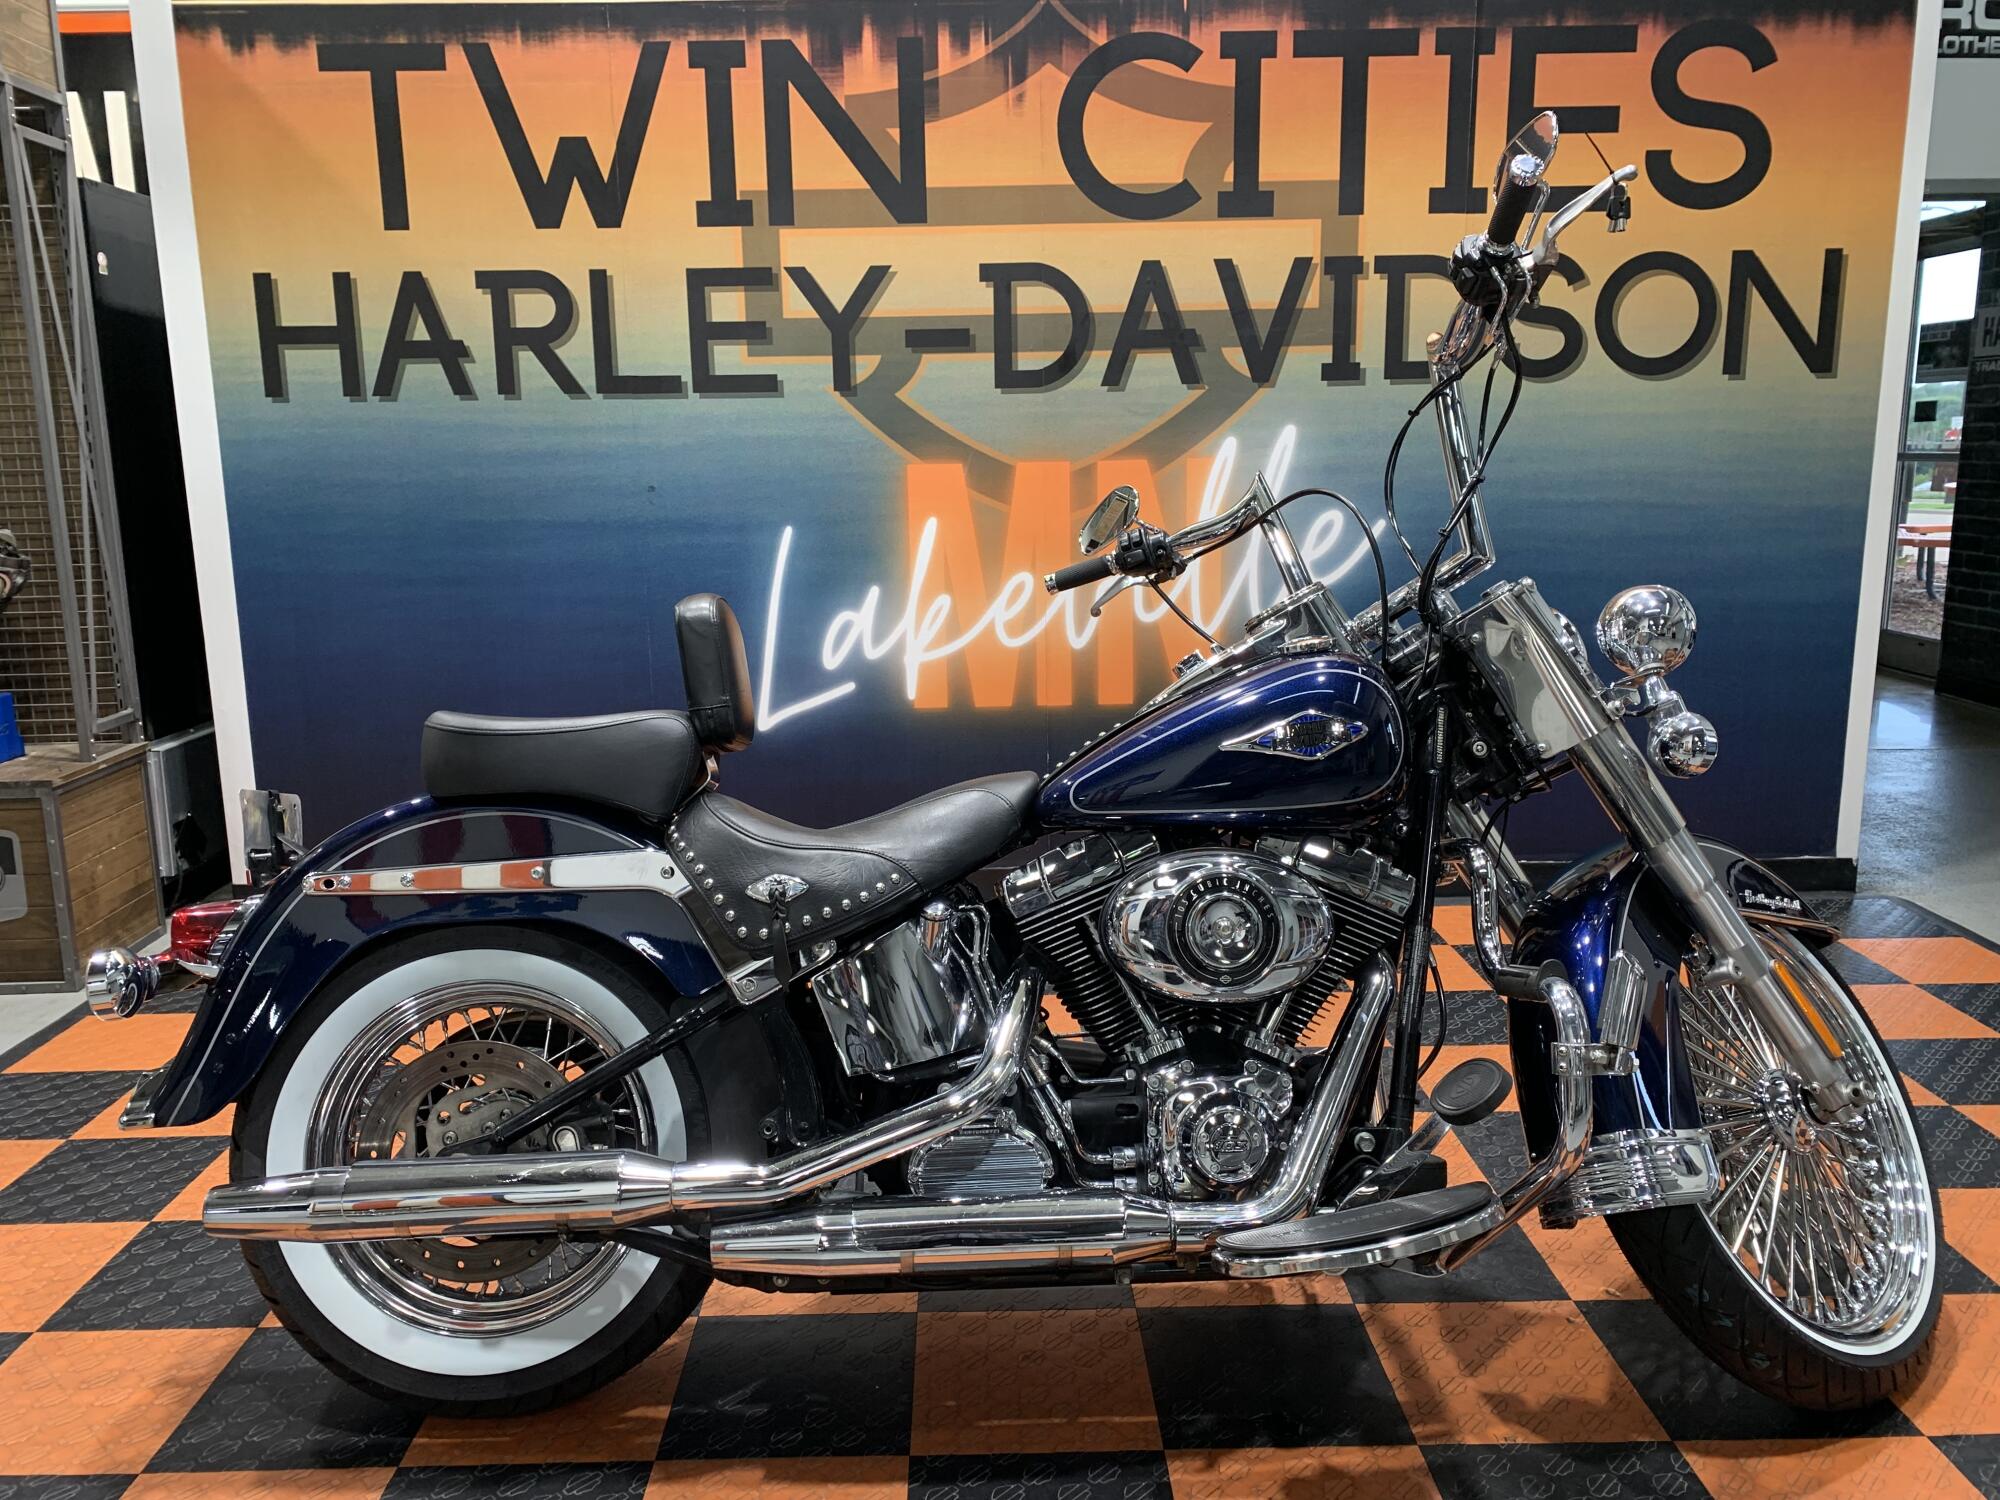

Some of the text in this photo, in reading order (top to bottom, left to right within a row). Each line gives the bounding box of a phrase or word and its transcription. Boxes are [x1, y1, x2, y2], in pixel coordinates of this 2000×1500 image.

[316, 36, 928, 231] TWIN
[1057, 17, 1779, 220] CITIES
[252, 247, 1849, 403] HARLEY-DAVIDSON
[906, 458, 1222, 709] MN
[1190, 878, 1228, 901] CUBIC
[1233, 880, 1275, 919] INCHES
